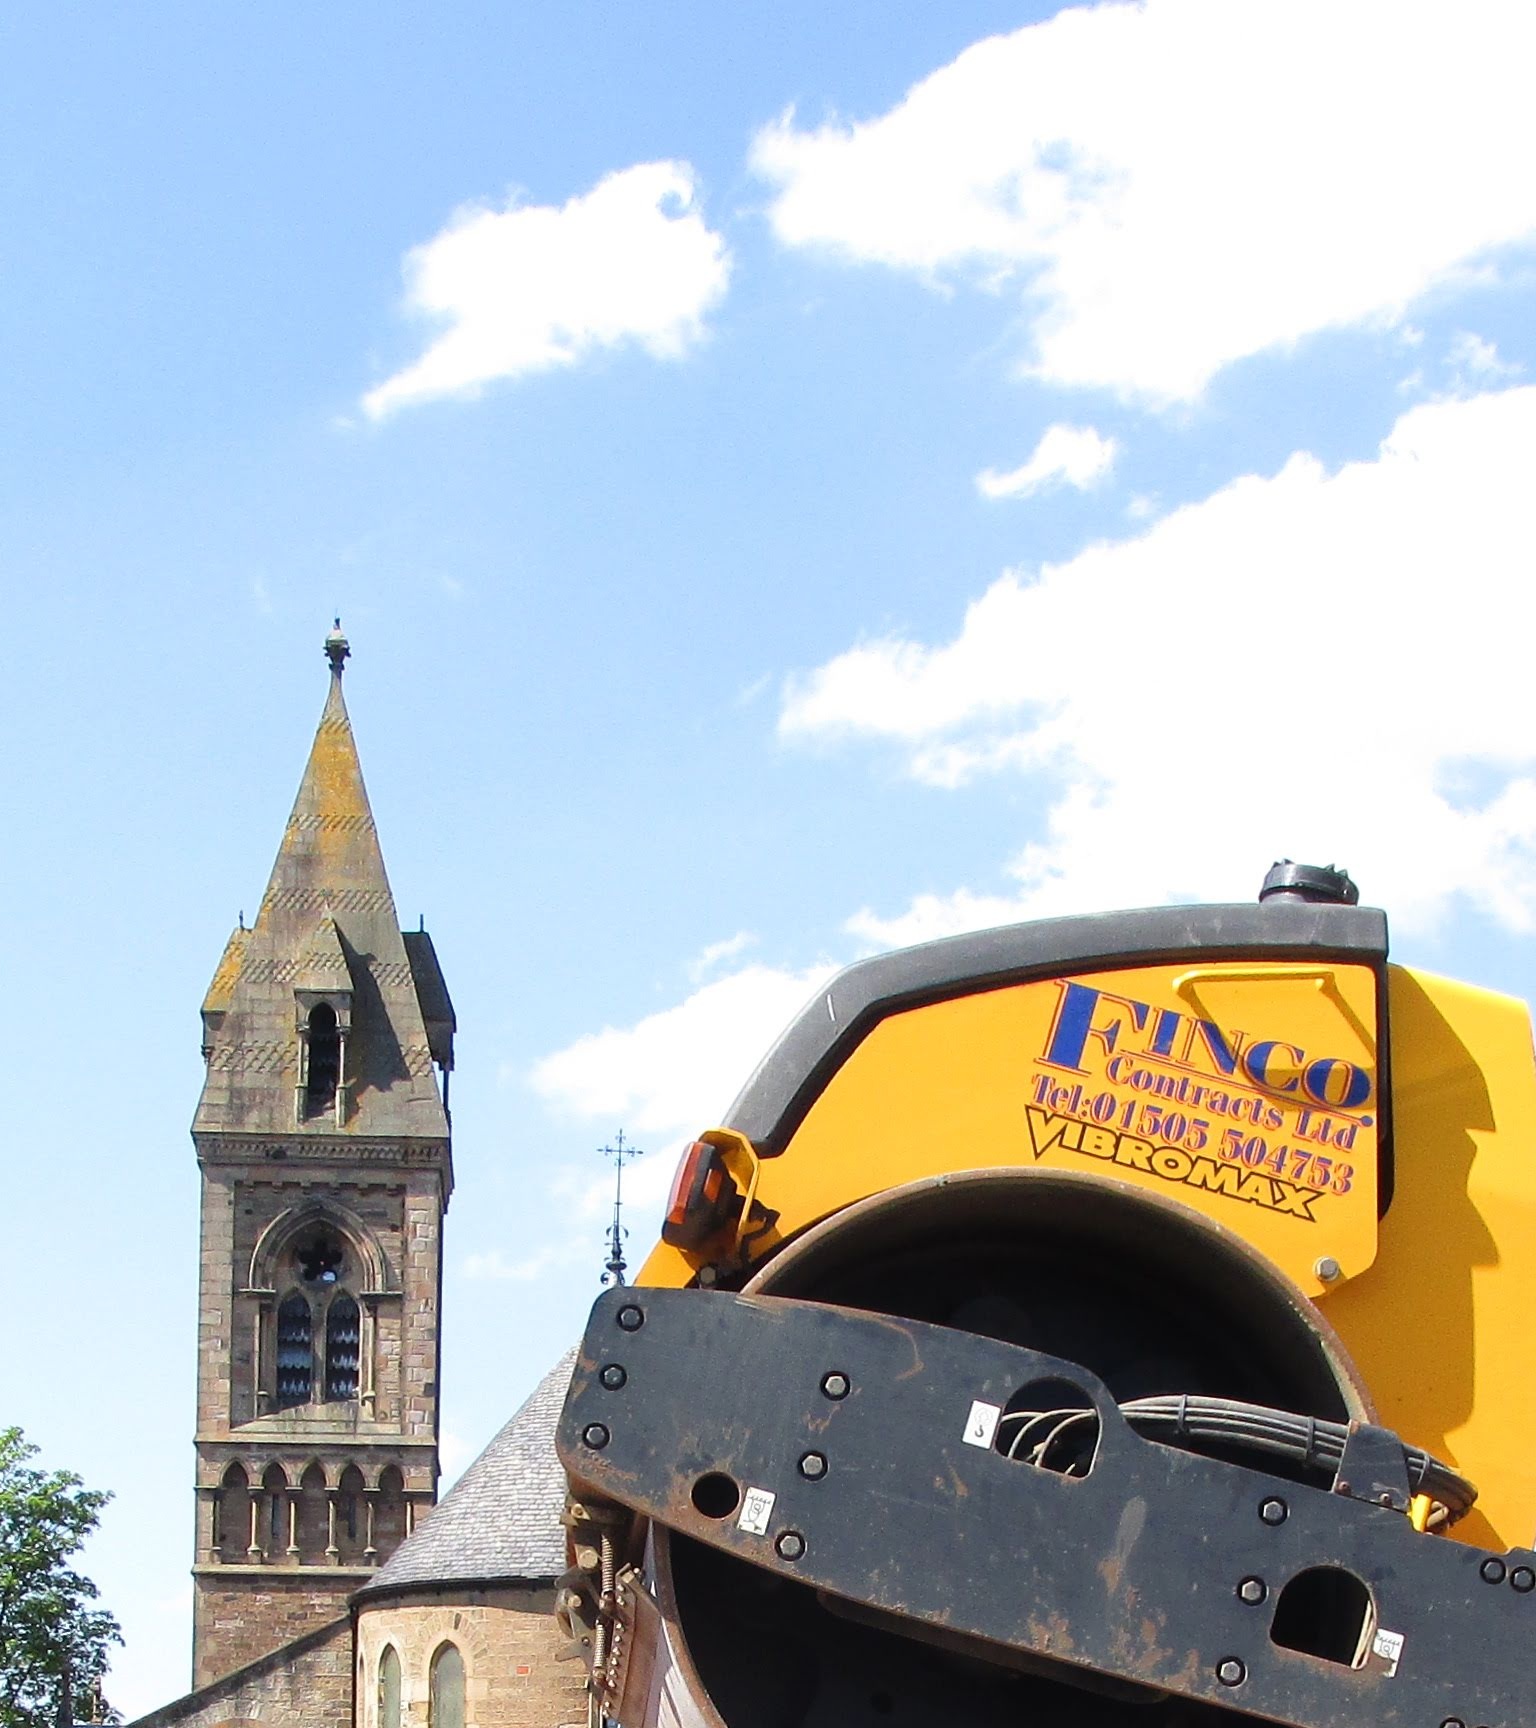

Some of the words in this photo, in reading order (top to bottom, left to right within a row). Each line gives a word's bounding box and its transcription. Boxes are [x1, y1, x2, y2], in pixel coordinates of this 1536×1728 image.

[1034, 979, 1372, 1108] FINCO
[1107, 1056, 1284, 1130] Contracts
[1294, 1108, 1360, 1150] Ltd
[1025, 1104, 1325, 1222] VIBROMAX
[1031, 1073, 1210, 1151] Tel:01505
[1217, 1128, 1355, 1195] 504753
